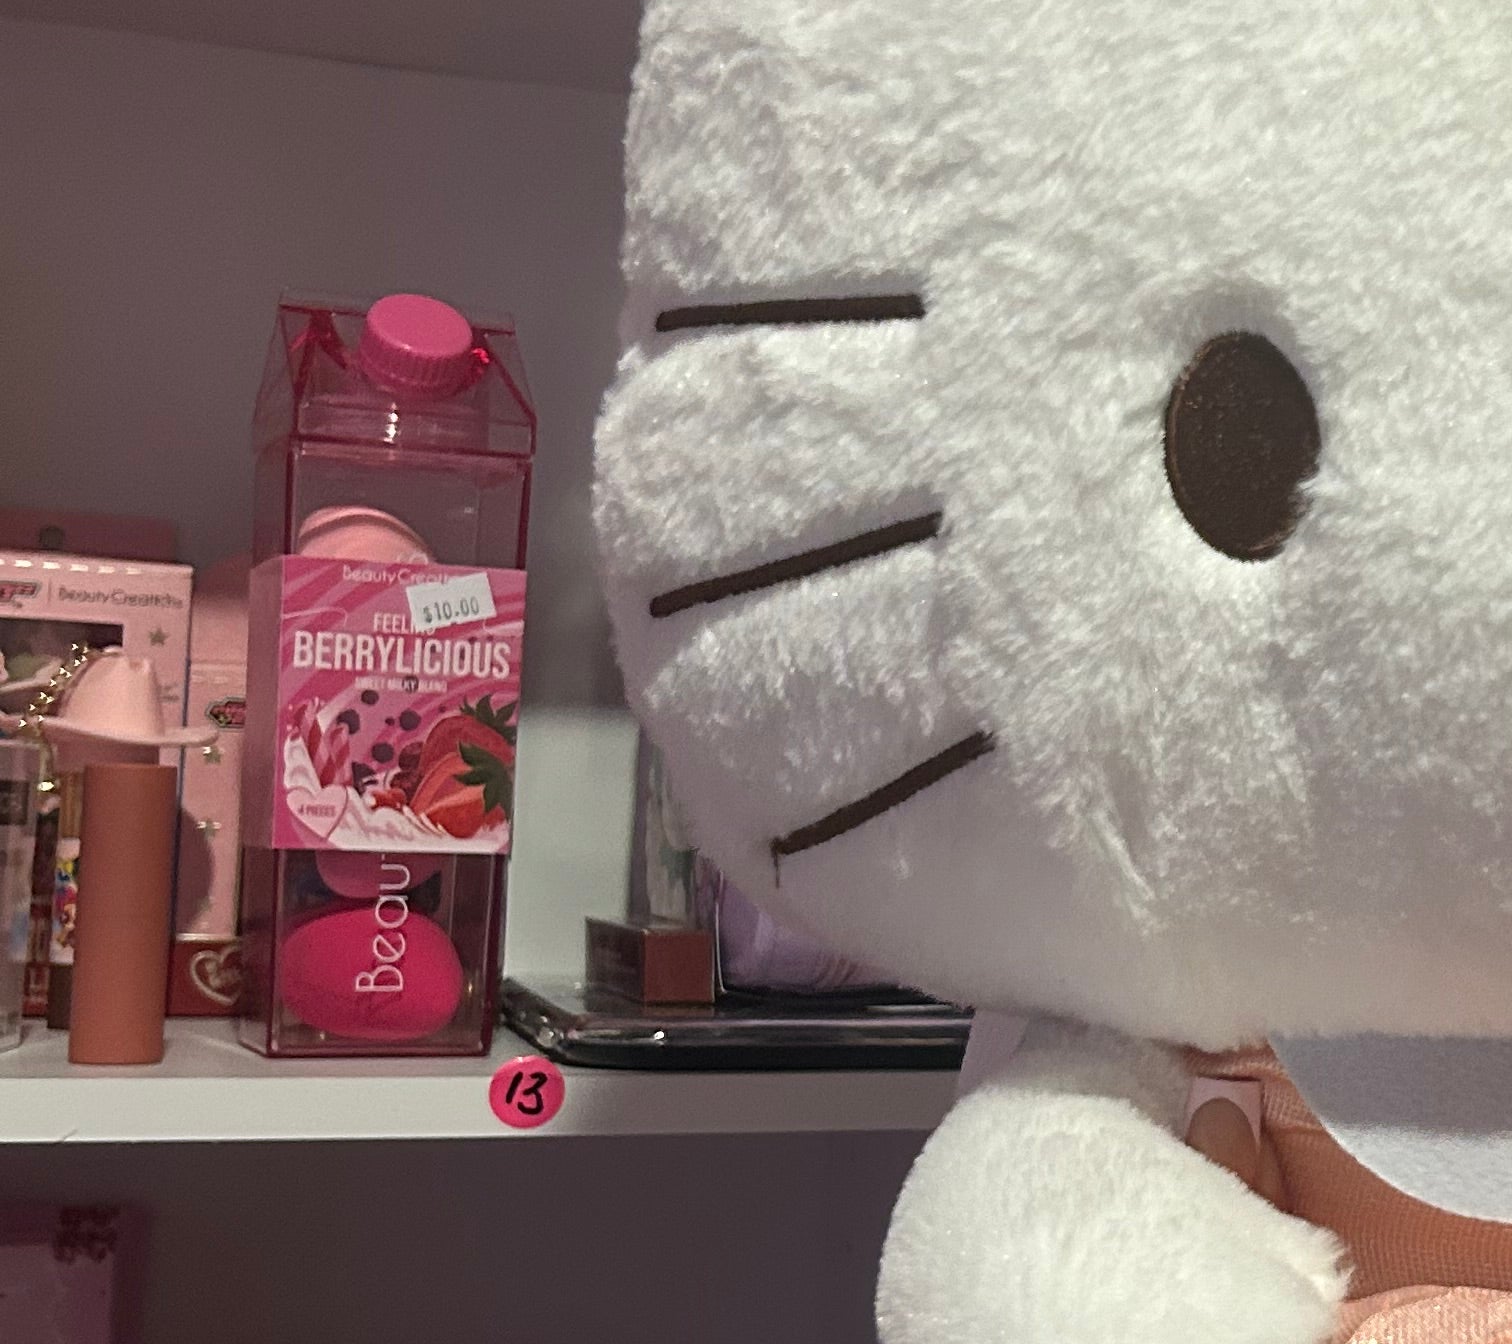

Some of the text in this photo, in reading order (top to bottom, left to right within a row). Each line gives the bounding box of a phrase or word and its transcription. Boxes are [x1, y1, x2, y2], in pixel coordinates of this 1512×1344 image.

[422, 596, 480, 624] $10.00
[293, 630, 511, 679] BERRYLICIOUS
[355, 853, 411, 993] Beau
[505, 1071, 548, 1115] 13
